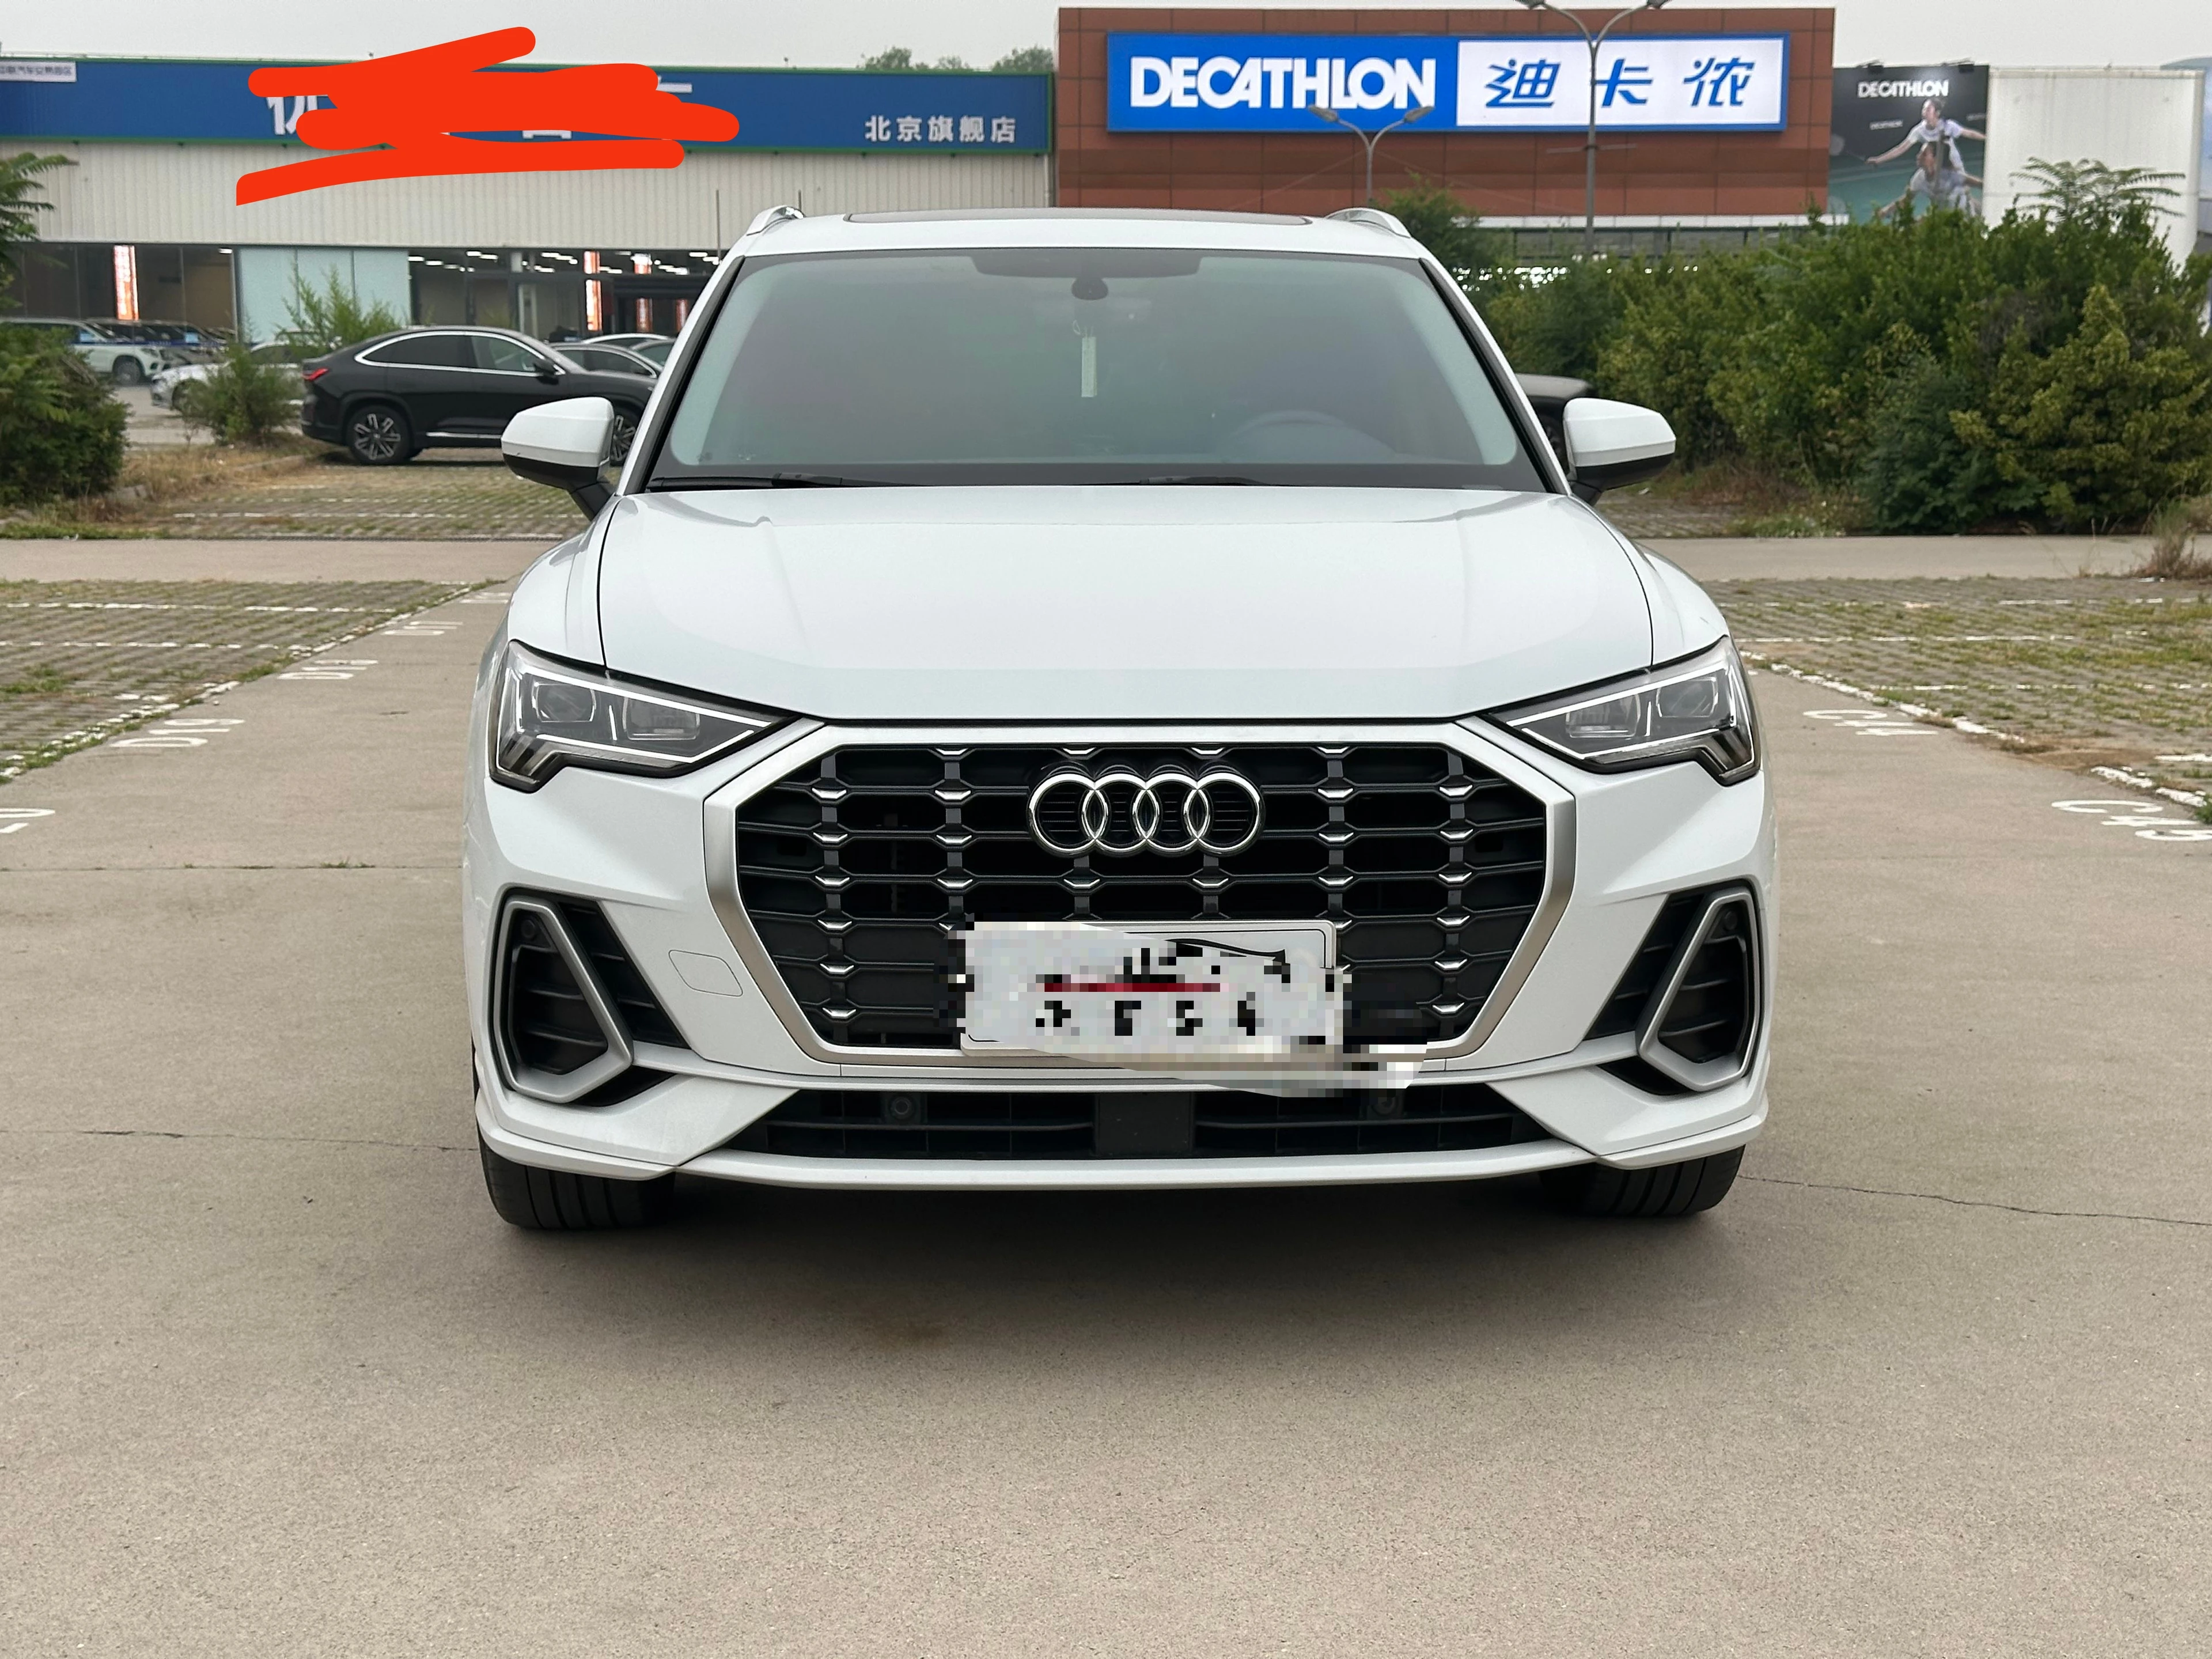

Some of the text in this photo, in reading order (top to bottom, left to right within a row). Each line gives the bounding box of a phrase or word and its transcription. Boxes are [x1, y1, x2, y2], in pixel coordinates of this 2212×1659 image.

[1131, 56, 1436, 109] DECATHLON
[1486, 57, 1755, 108] 迪卡侬
[1858, 79, 1950, 99] DECATHLON
[865, 115, 1016, 143] 北京旗舰店
